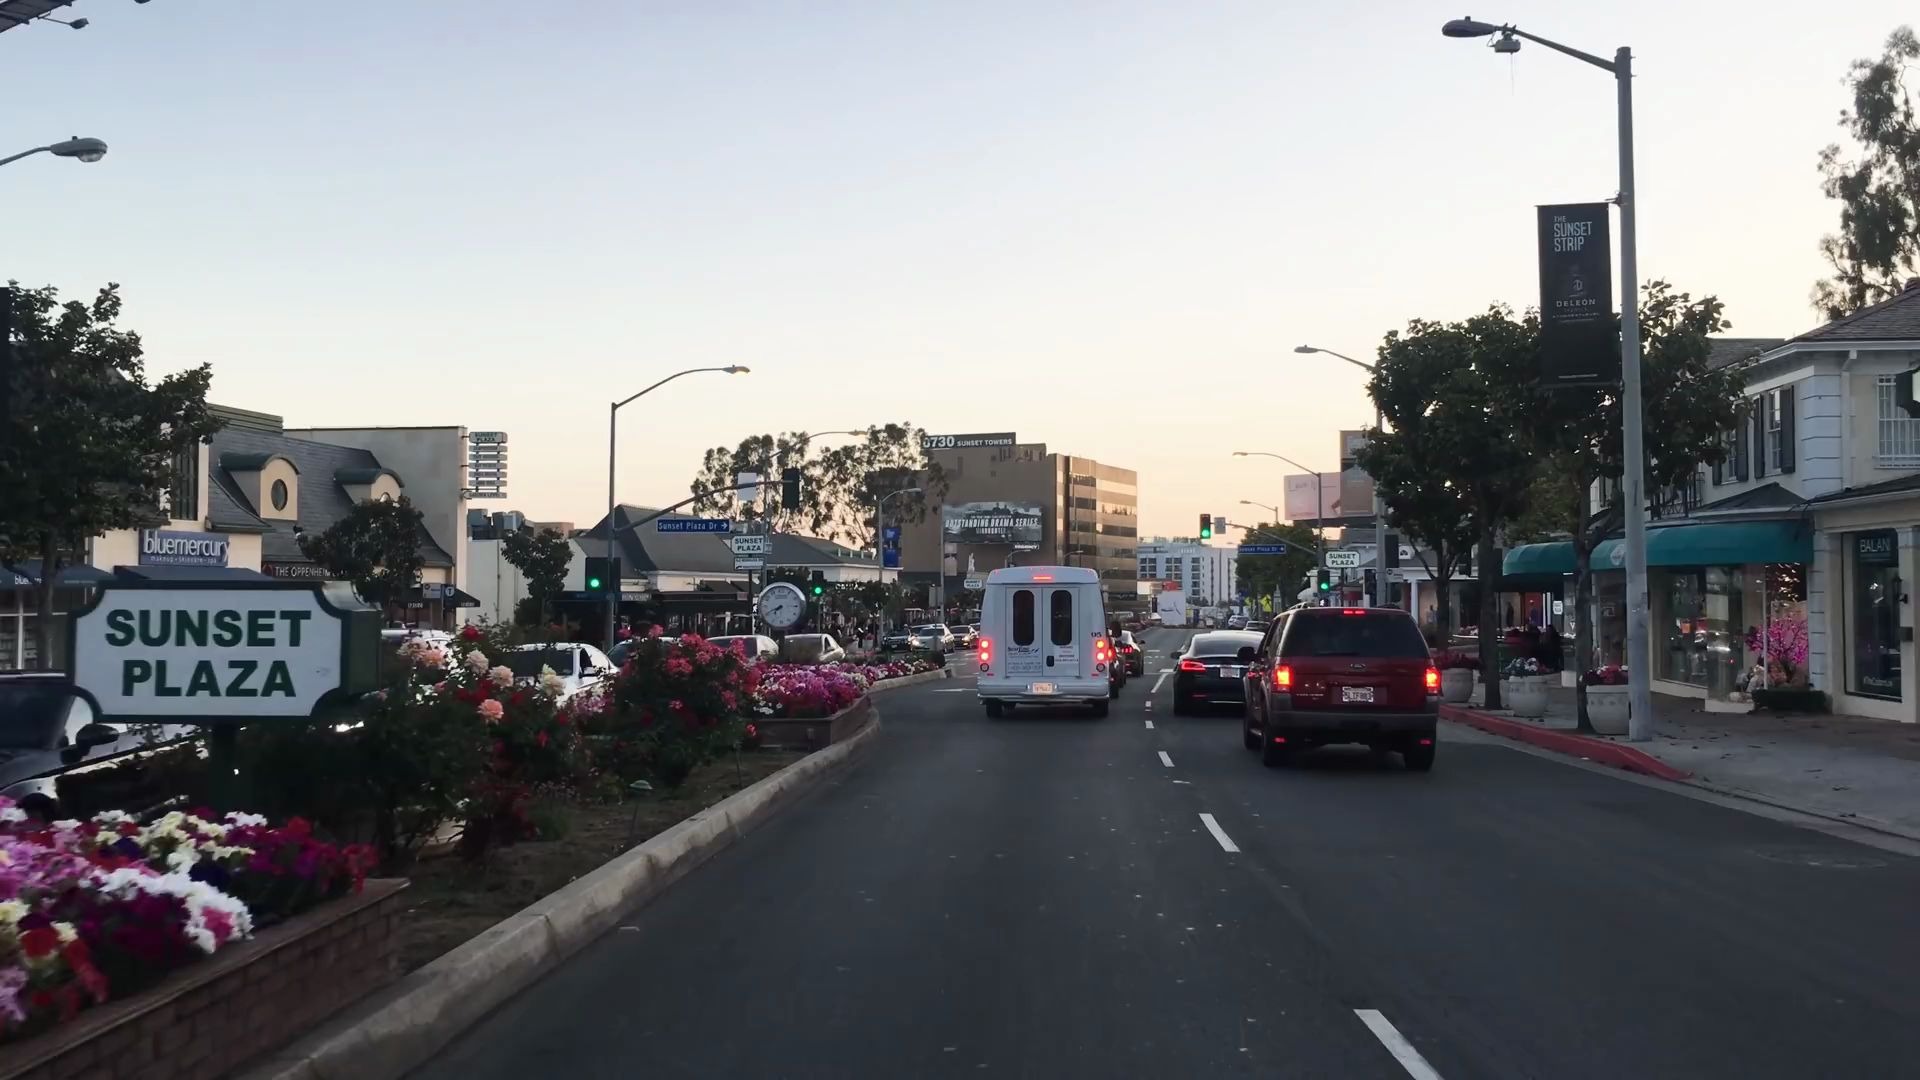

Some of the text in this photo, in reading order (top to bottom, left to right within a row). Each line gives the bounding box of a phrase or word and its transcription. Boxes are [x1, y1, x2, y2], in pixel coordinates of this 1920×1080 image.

[1554, 222, 1592, 237] SUNSET
[1554, 237, 1584, 252] STRIP
[956, 439, 983, 447] SUNSET
[985, 438, 1012, 446] TOWERS
[658, 521, 717, 530] Sunset Plaza Dr
[945, 517, 1039, 528] OUTSTANDING DRAMA SERIES
[143, 529, 231, 562] bluemercury
[275, 566, 289, 577] THE
[105, 609, 312, 648] SUNSET
[121, 660, 297, 698] PLAZA
